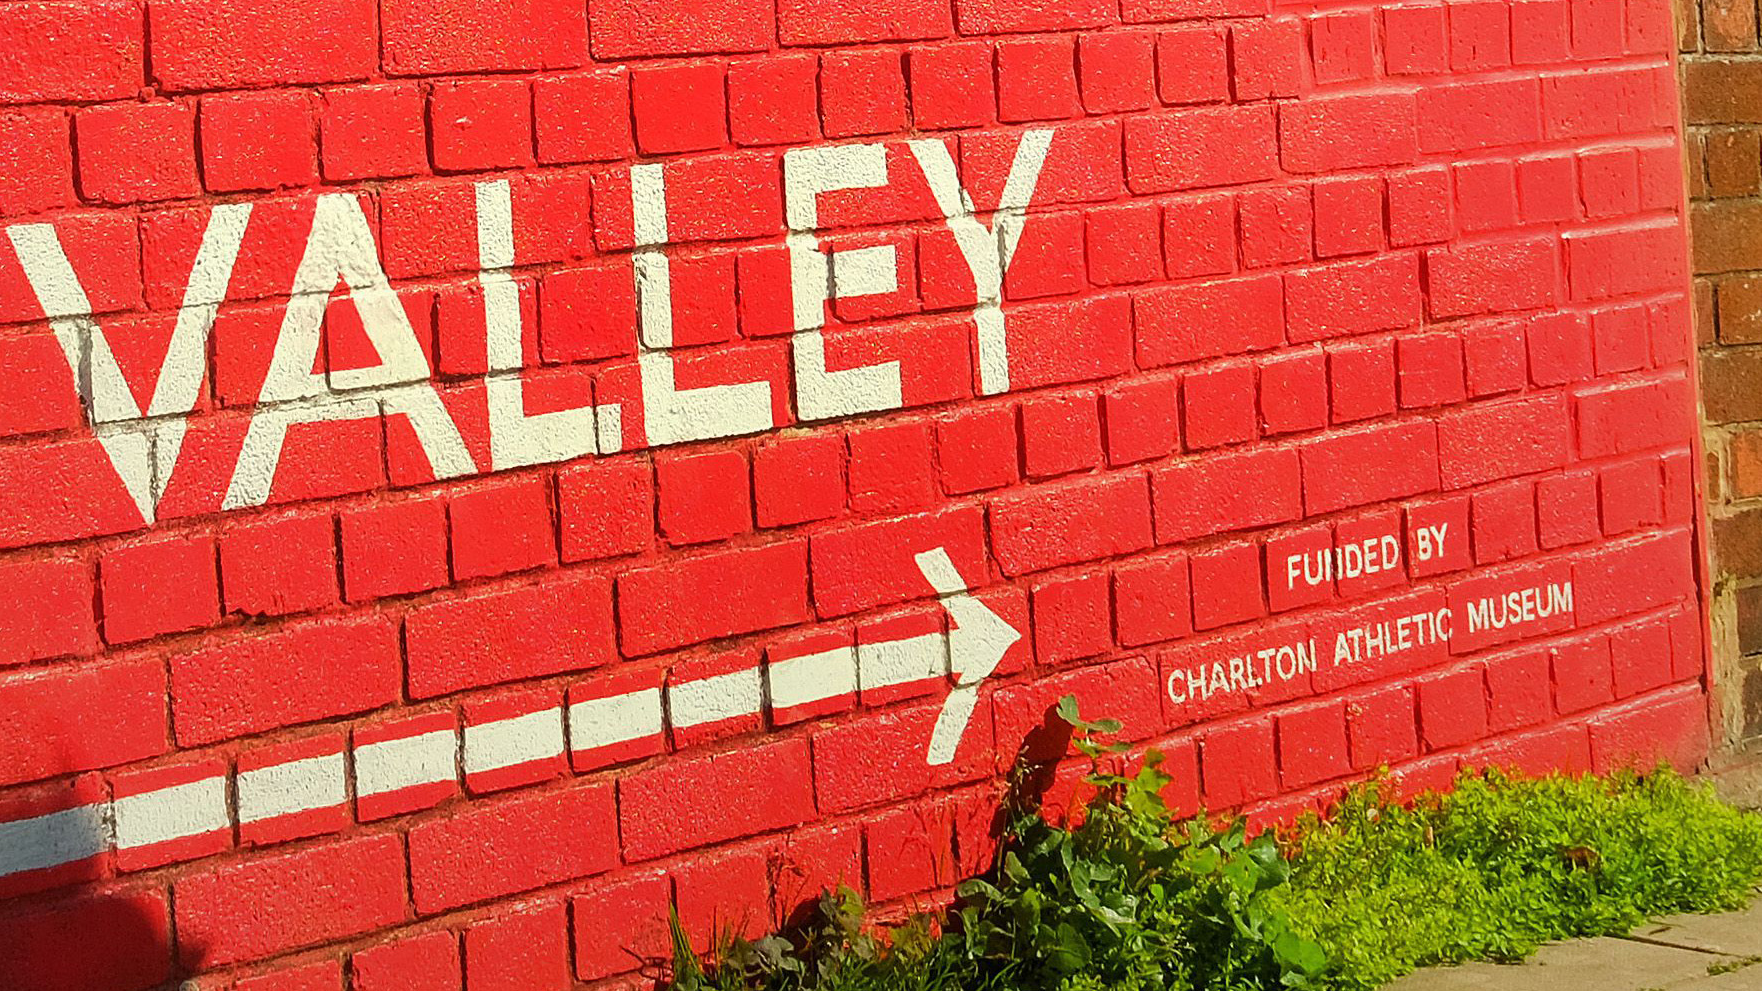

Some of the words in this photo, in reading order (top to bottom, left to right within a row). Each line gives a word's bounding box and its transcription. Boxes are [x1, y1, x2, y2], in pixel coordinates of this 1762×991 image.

[6, 128, 1056, 525] VALLEY
[1287, 534, 1400, 589] FUNDED
[1417, 522, 1448, 561] BY
[1167, 639, 1317, 704] CHARLTON
[1333, 608, 1453, 667] ATHLETIC
[1467, 582, 1574, 634] MUSEUM
